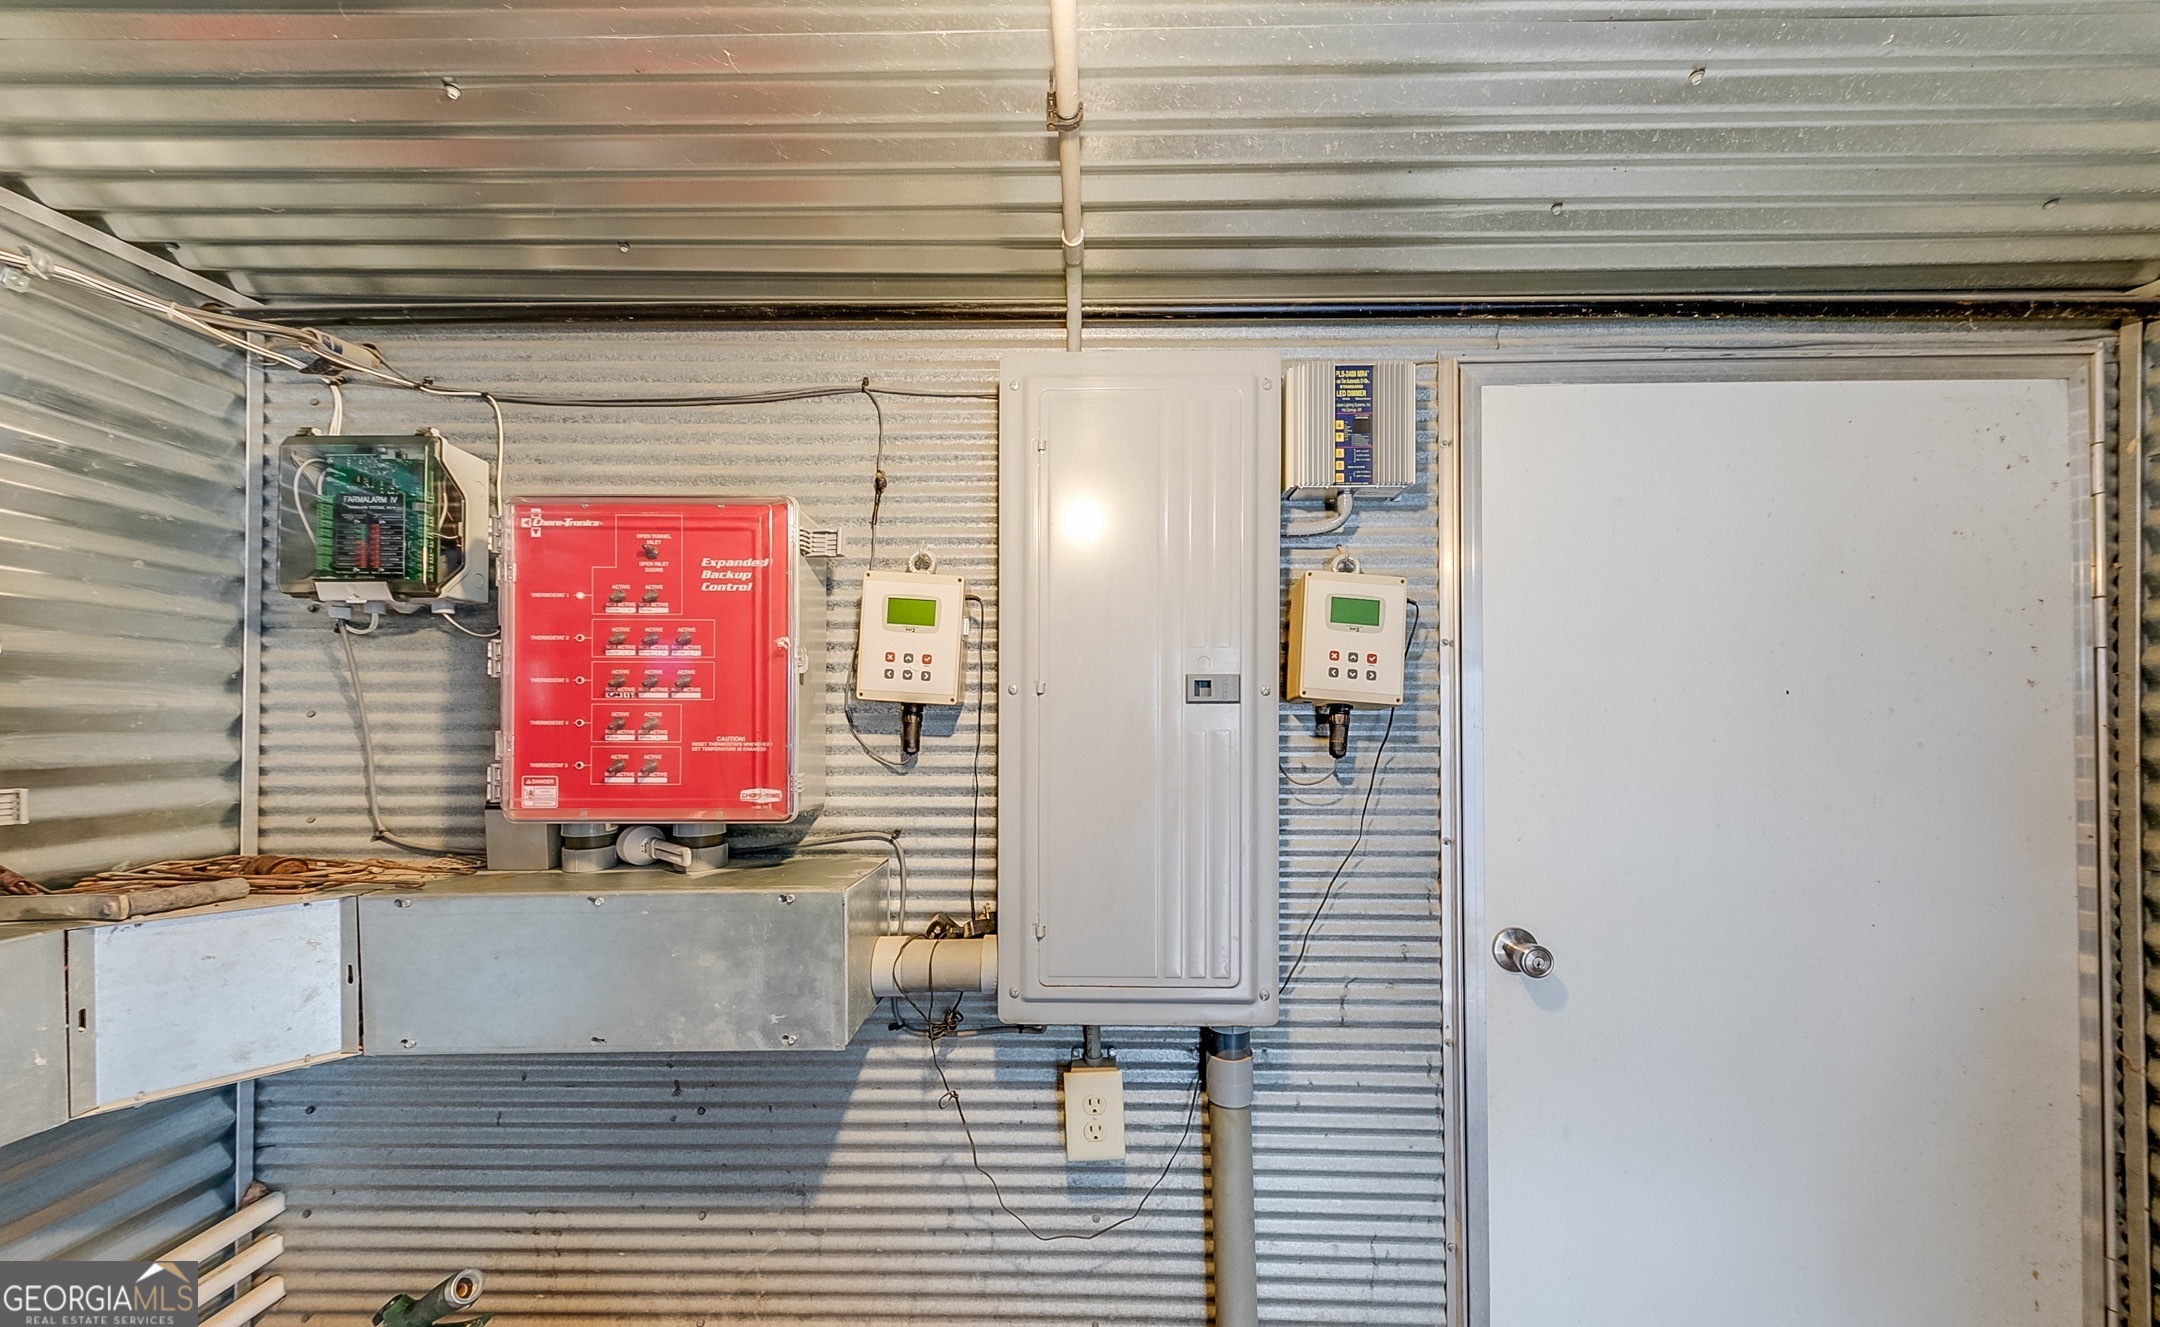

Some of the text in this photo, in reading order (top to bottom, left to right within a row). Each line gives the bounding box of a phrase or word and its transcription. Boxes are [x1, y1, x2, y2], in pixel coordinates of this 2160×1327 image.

[701, 557, 769, 568] Expanded
[701, 570, 752, 581] Backup
[701, 582, 753, 592] Control
